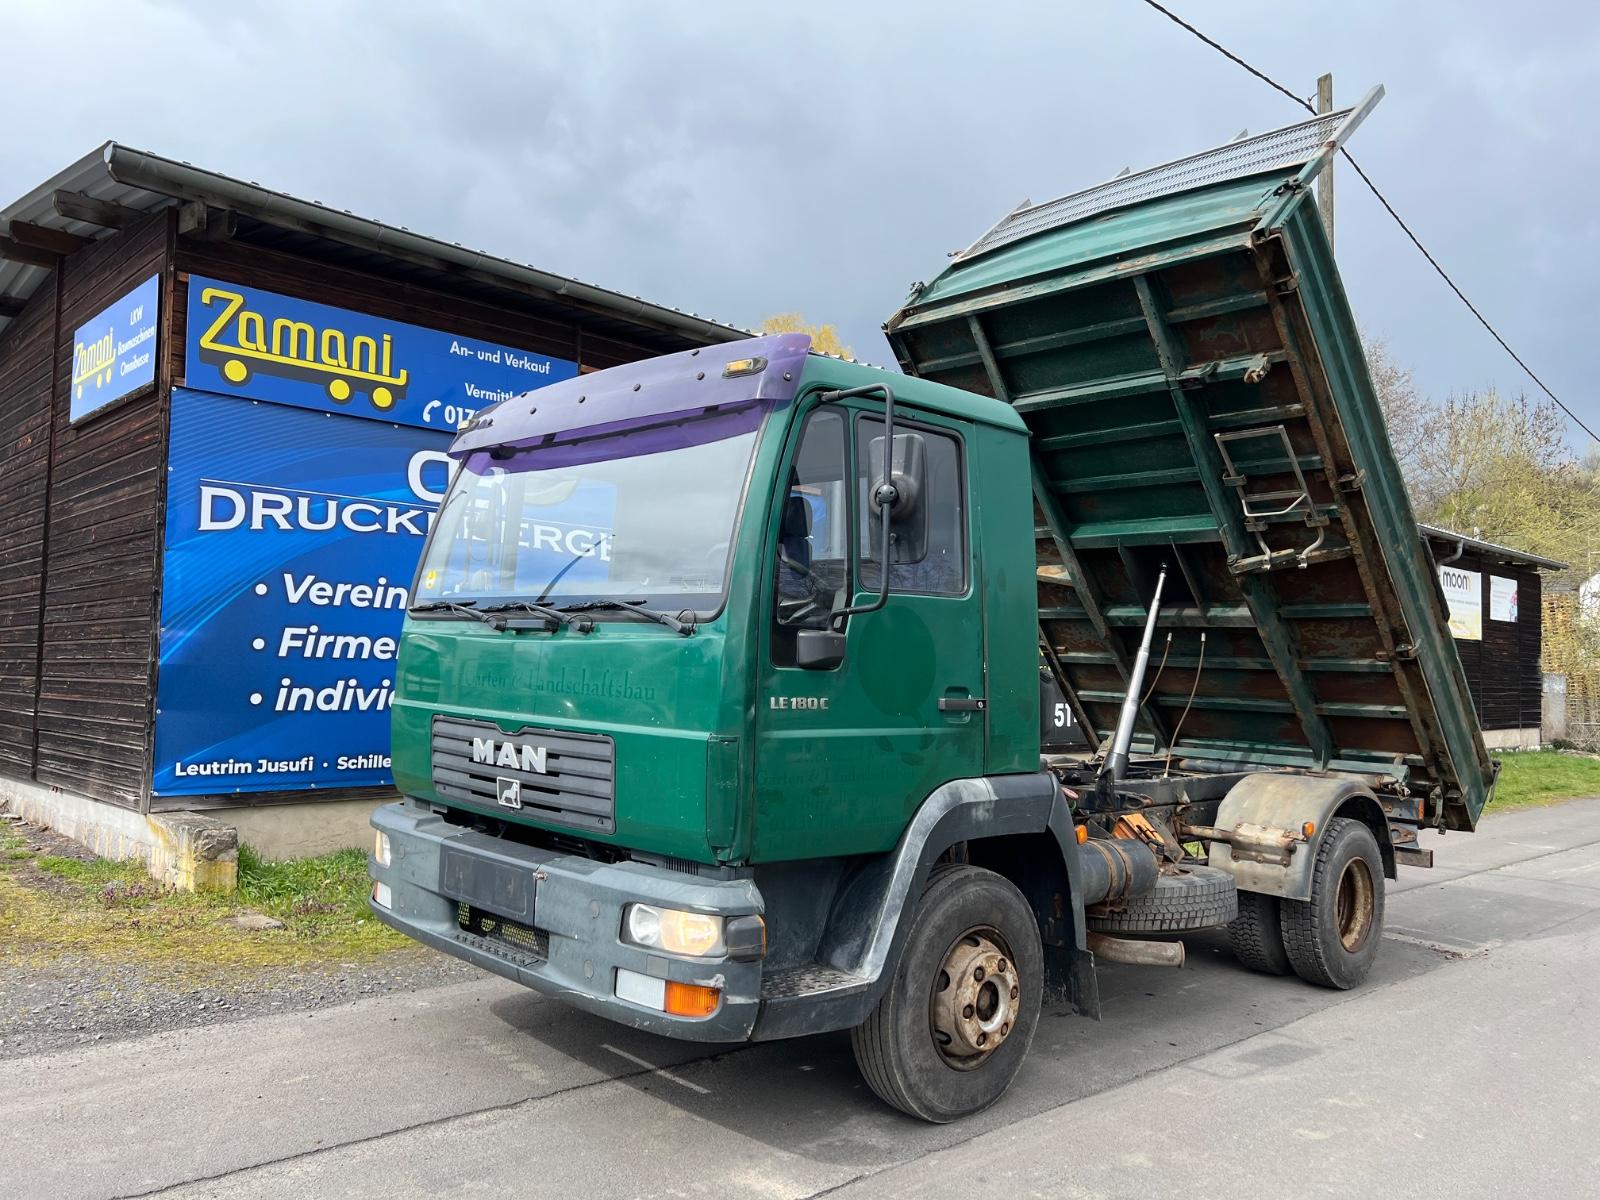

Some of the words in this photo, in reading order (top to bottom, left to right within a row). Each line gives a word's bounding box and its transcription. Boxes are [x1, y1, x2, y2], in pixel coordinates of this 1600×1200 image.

[200, 287, 408, 386] Zamani
[74, 327, 116, 384] Zamani
[450, 341, 474, 358] An-
[477, 349, 501, 364] und
[504, 352, 551, 375] Verkauf
[444, 404, 480, 428] 017
[283, 573, 409, 610] Verein
[278, 624, 400, 660] Firme
[274, 677, 395, 711] indivi
[1053, 702, 1078, 727] 51
[175, 758, 252, 776] Leutrim
[256, 756, 314, 773] Jusufi
[336, 754, 392, 770] Schille
[472, 737, 548, 774] MAN
